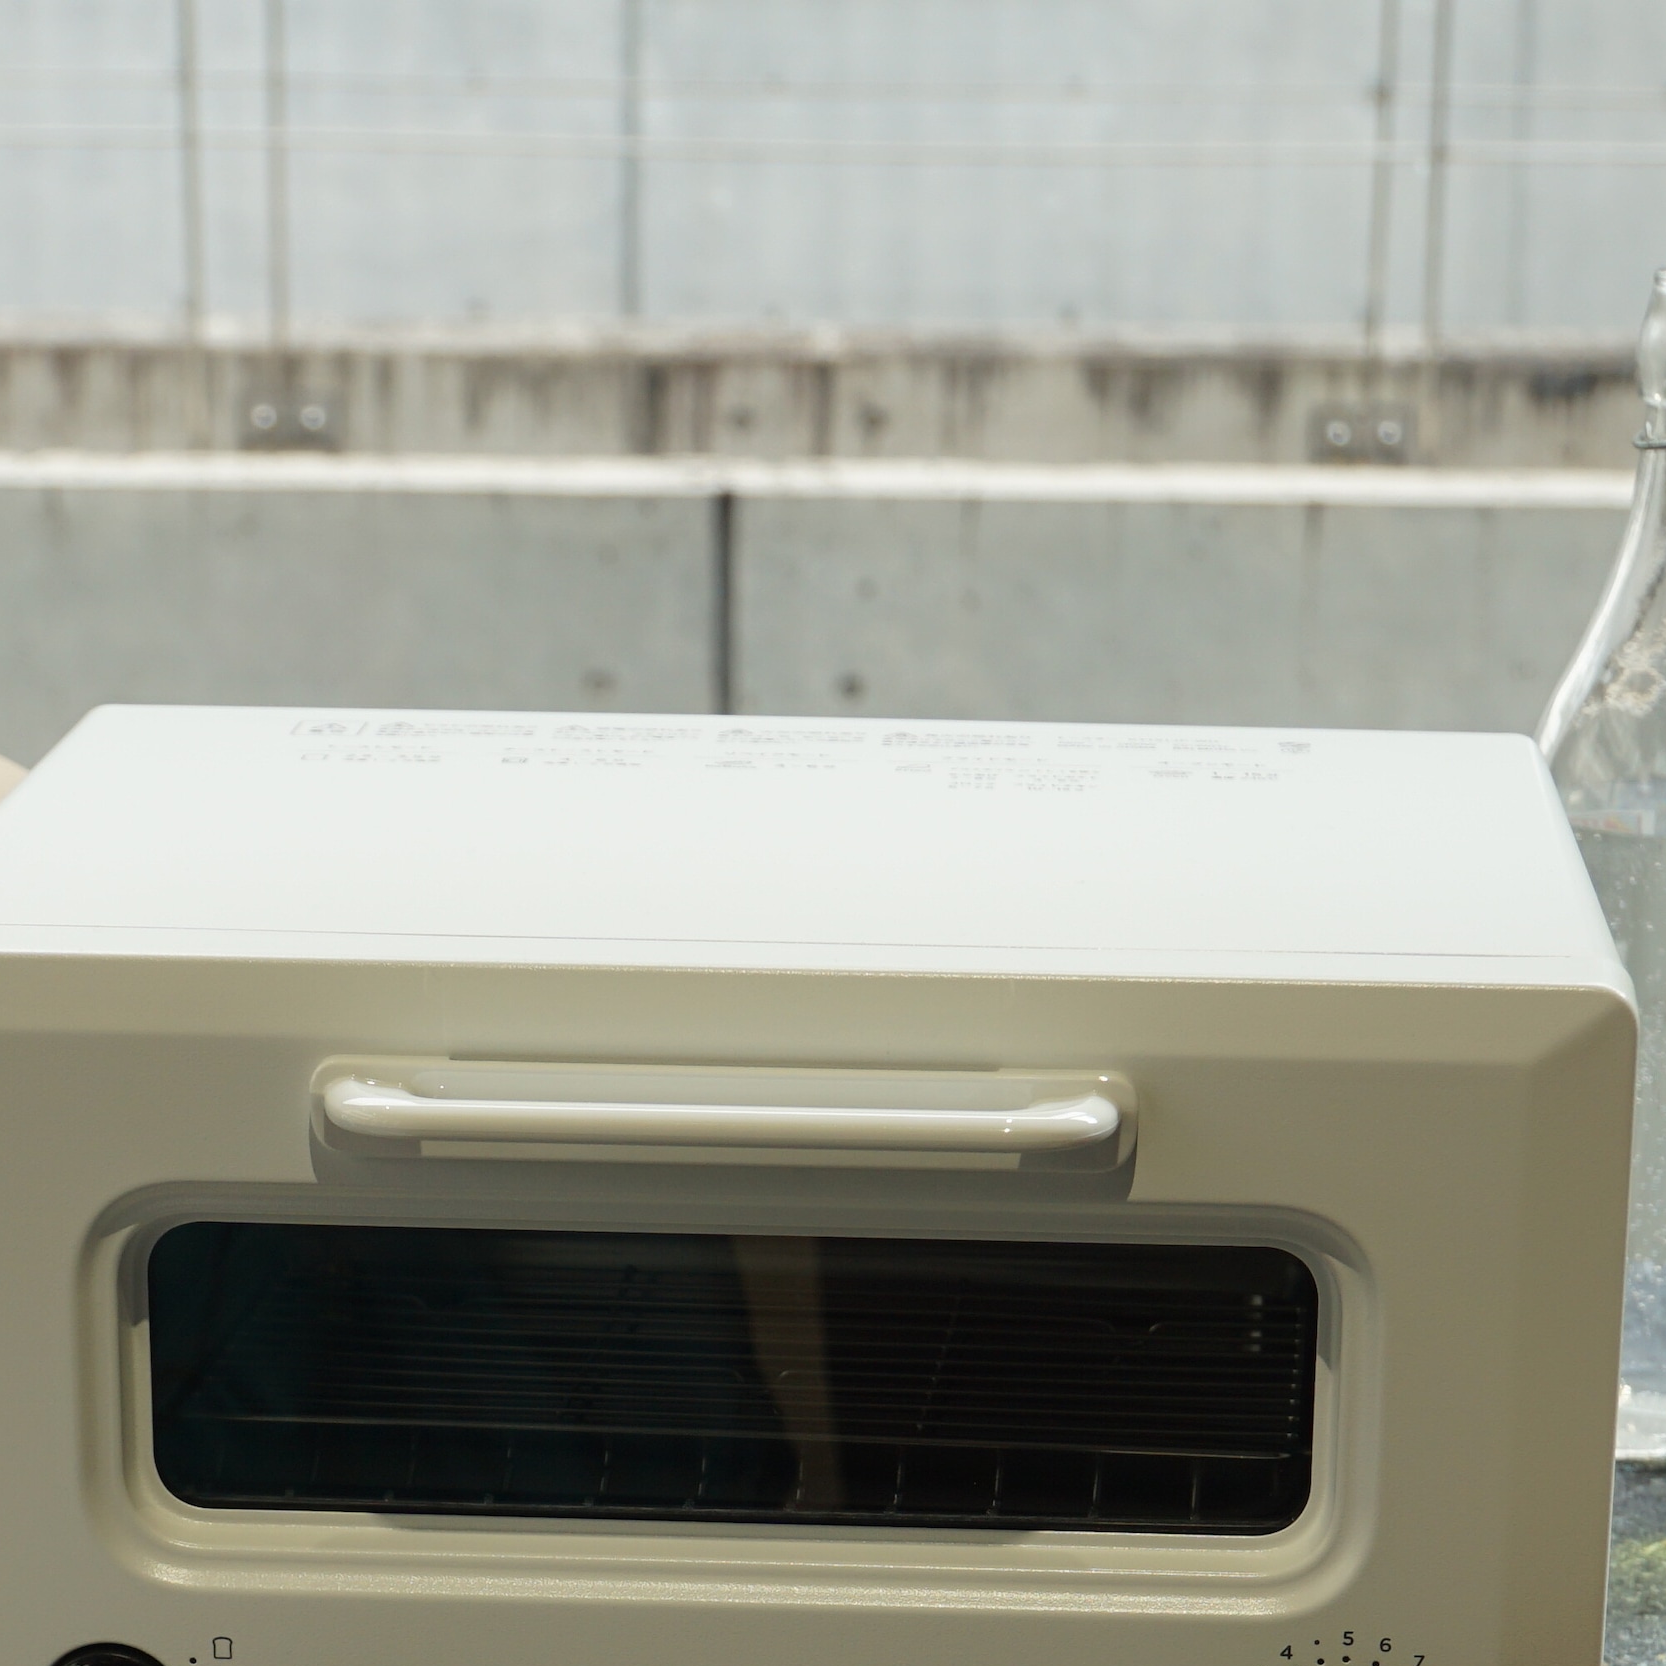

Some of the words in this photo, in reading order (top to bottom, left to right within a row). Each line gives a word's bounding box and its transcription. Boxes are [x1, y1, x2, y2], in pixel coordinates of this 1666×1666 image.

[1342, 1631, 1355, 1646] 5
[1379, 1638, 1393, 1653] 6
[1279, 1645, 1294, 1660] 4
